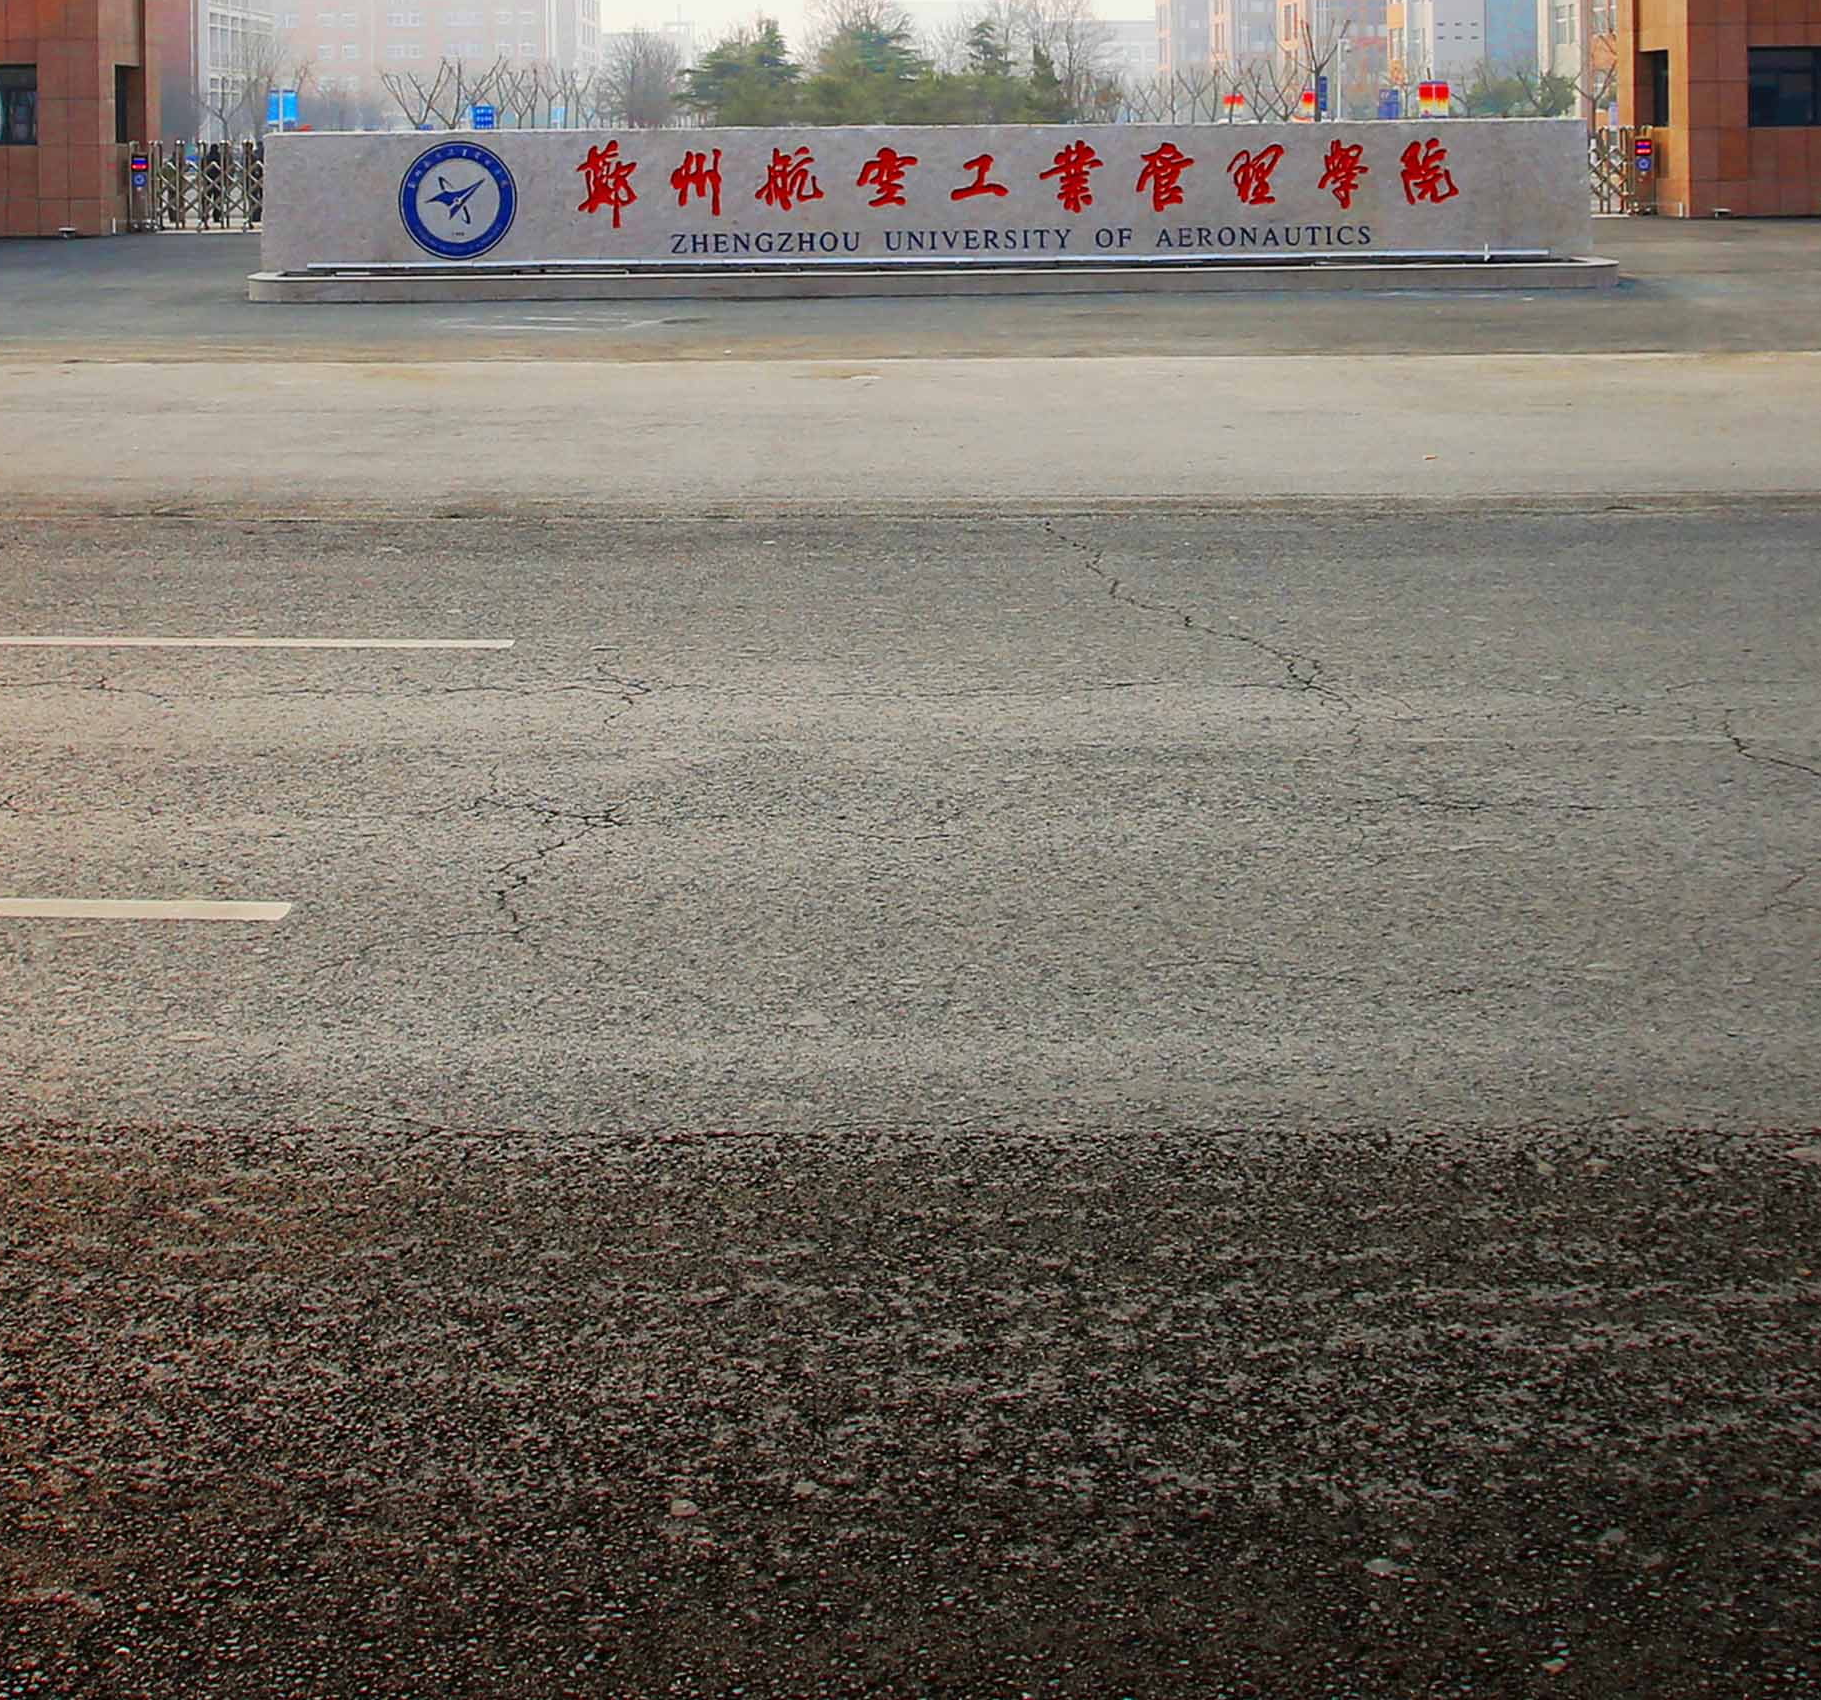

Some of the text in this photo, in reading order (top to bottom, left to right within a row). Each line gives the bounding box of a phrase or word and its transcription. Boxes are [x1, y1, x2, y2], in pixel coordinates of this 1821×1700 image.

[670, 225, 1372, 254] ZHENGZHOU UNIVERSITY OF AERONAUTICS
